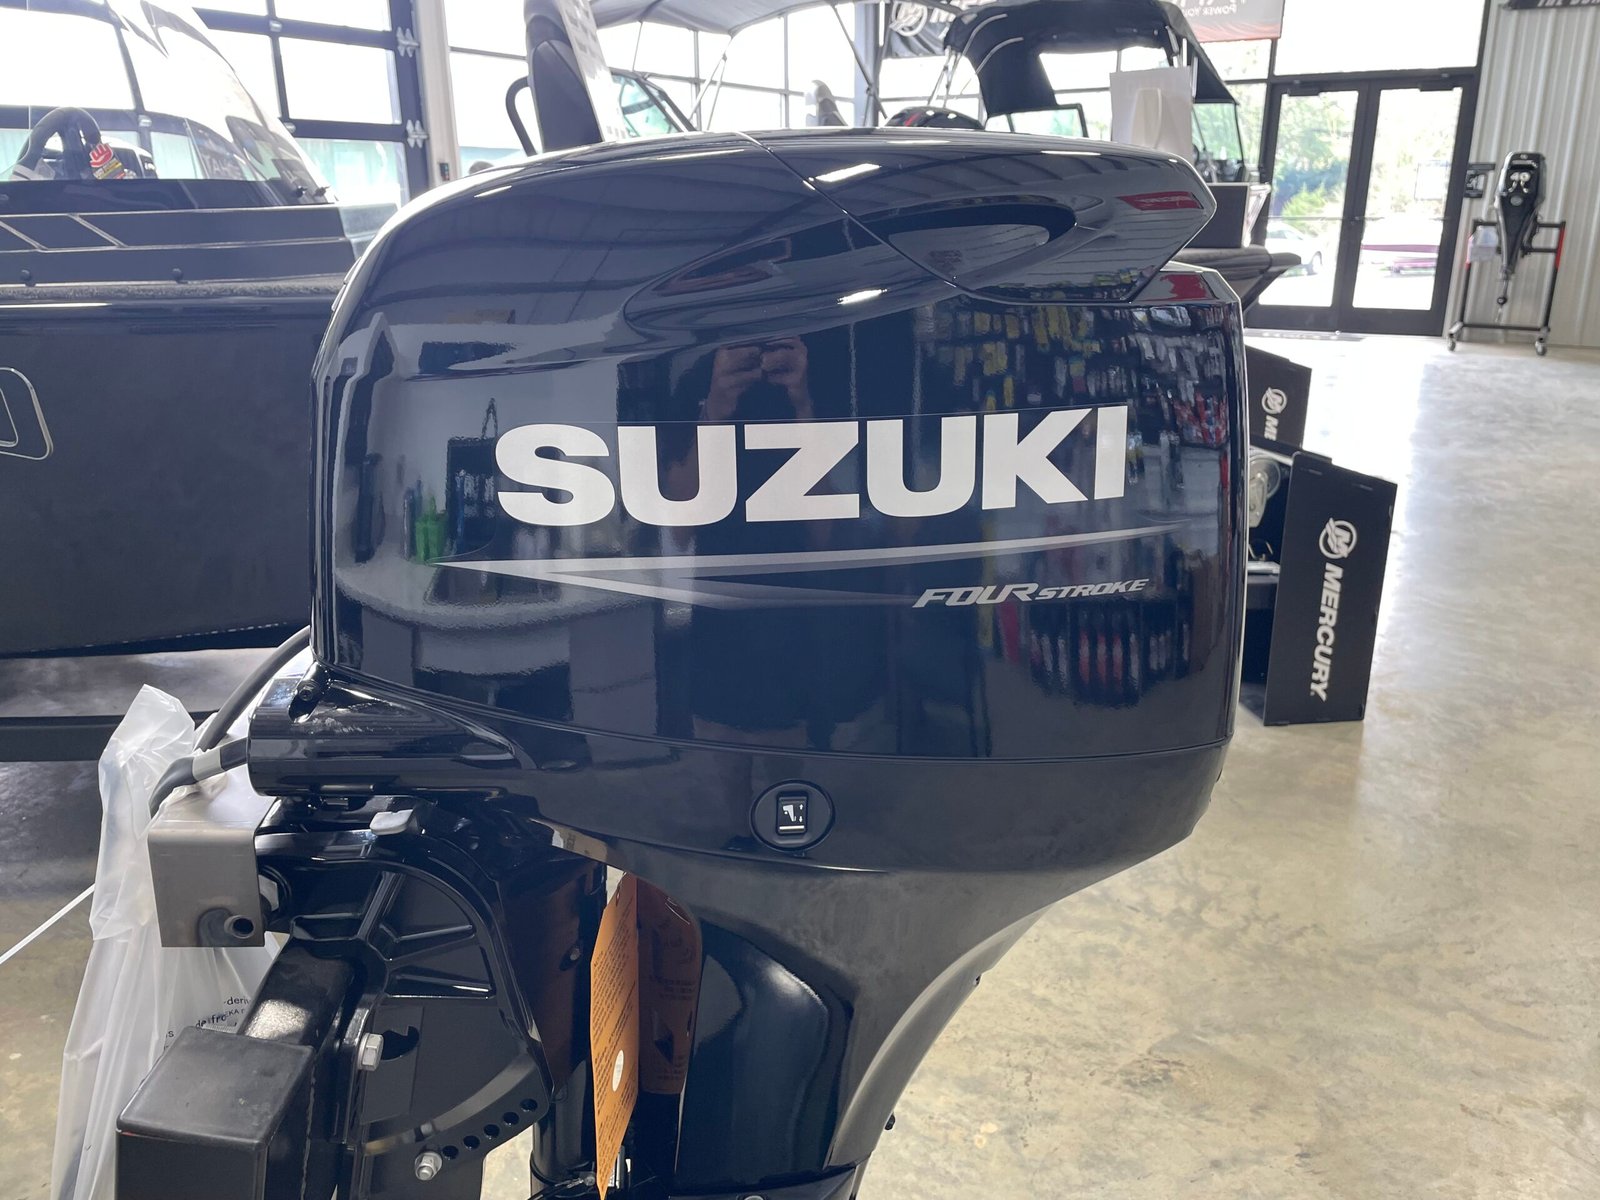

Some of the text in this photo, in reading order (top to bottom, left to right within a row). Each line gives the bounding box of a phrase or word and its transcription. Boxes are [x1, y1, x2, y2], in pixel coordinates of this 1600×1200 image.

[495, 405, 1128, 527] SUZUKI
[912, 578, 1150, 608] FOUR STROKE
[1310, 562, 1343, 701] MERCURY
